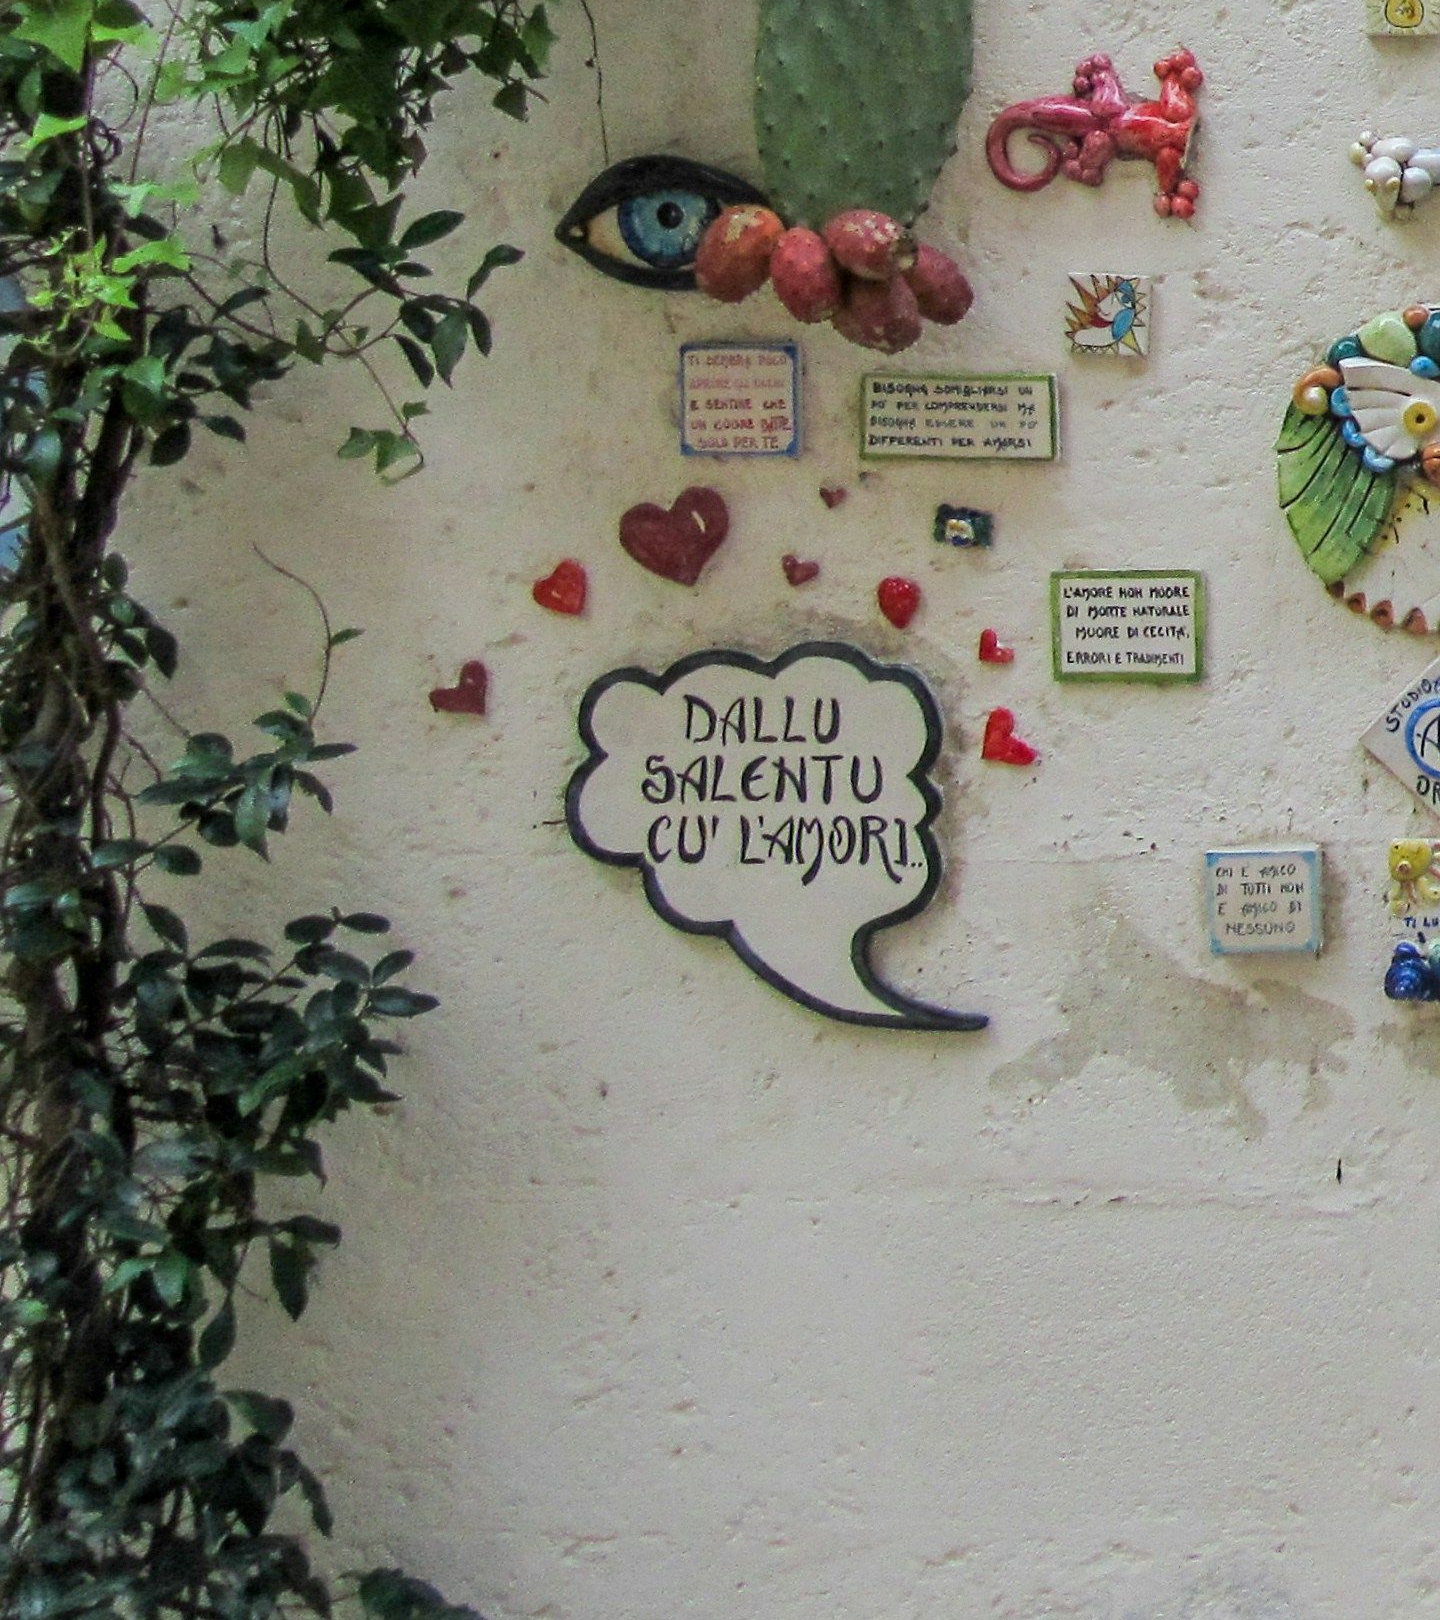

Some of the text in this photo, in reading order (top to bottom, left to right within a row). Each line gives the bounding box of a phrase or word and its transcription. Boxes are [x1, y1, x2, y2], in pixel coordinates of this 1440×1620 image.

[1064, 586, 1113, 599] L'AMORE
[1119, 587, 1143, 597] NON
[1067, 606, 1190, 618] DI MORTE NATURALE
[1076, 628, 1119, 639] MUORE
[1128, 628, 1139, 638] DI
[1067, 653, 1112, 664] ERRORI
[1116, 654, 1122, 664] E
[685, 693, 842, 744] DALLU
[641, 755, 883, 805] SALENTU
